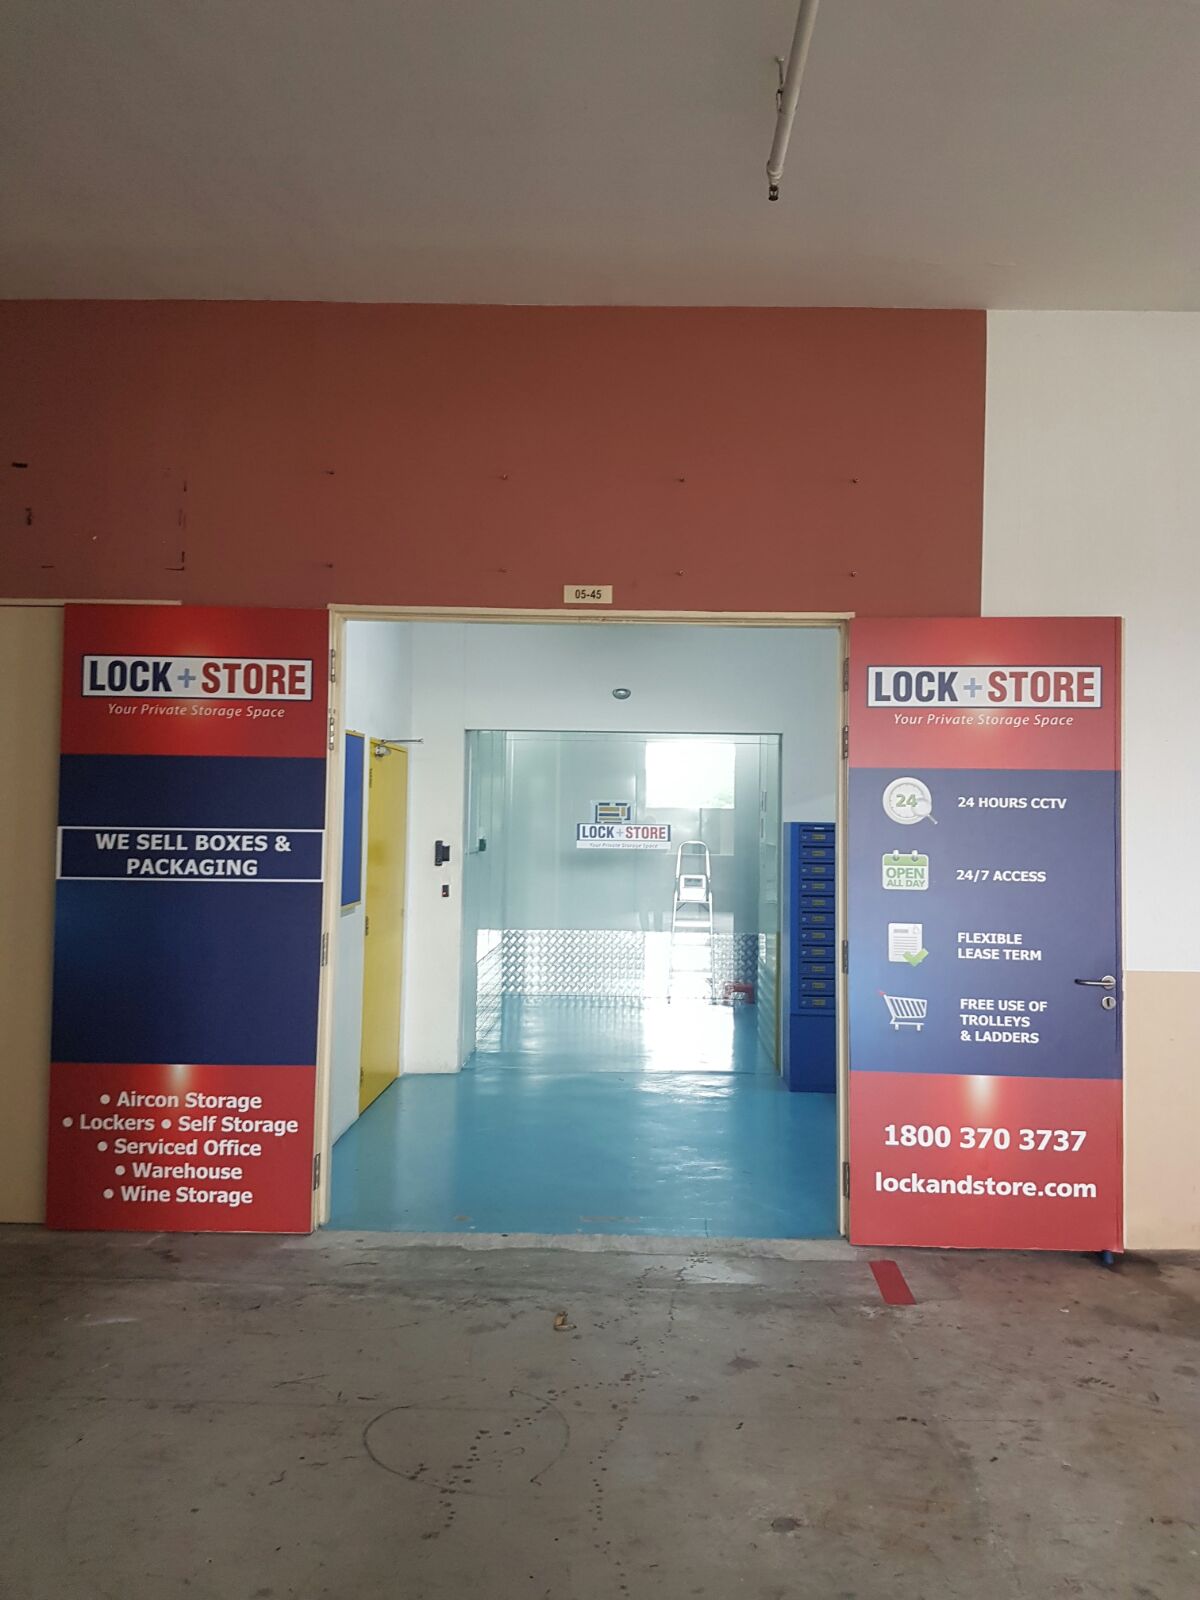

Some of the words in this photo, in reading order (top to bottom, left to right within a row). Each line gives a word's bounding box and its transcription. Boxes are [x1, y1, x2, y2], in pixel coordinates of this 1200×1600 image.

[575, 589, 602, 599] 05-45
[89, 660, 173, 693] LOCK
[202, 662, 306, 694] STORE
[874, 671, 959, 703] LOCK
[987, 671, 1095, 703] STORE
[107, 703, 137, 716] Your
[140, 703, 187, 716] Private
[190, 704, 242, 719] Storage
[246, 706, 286, 719] Space
[894, 713, 923, 726] Your
[927, 713, 974, 726] Private
[977, 714, 1030, 729] Storage
[1033, 715, 1074, 728] Space
[958, 796, 975, 809] 24
[978, 797, 1028, 809] HOURS
[1031, 798, 1067, 810] CCTV
[582, 826, 614, 838] LOCK
[625, 826, 667, 840] STORE
[95, 833, 130, 850] WE
[136, 834, 188, 851] SELL
[195, 835, 268, 852] BOXES
[274, 836, 292, 852] &
[126, 858, 259, 876] PACKAGING
[885, 867, 926, 880] OPEN
[886, 879, 904, 888] ALL
[905, 879, 926, 888] DAY
[956, 870, 989, 882] 24/7
[993, 870, 1047, 882] ACCESS
[957, 932, 1023, 945] FLEXIBLE
[957, 947, 1000, 960] LEASE
[1002, 948, 1042, 961] TERM
[960, 998, 995, 1011] FREE
[998, 1000, 1026, 1012] USE
[1028, 1000, 1048, 1012] OF
[960, 1014, 1031, 1028] TROLLEYS
[960, 1030, 972, 1042] &
[975, 1031, 1039, 1044] LADDERS
[117, 1091, 179, 1108] Aircon
[184, 1091, 263, 1112] Storage
[80, 1113, 155, 1131] Lockers
[178, 1115, 217, 1132] Self
[221, 1117, 299, 1137] Storage
[884, 1124, 951, 1148] 1800
[959, 1128, 1010, 1150] 370
[1018, 1129, 1087, 1152] 3737
[114, 1138, 198, 1155] Serviced
[203, 1139, 262, 1157] Office
[132, 1162, 243, 1180] Warehouse
[875, 1171, 1097, 1199] lockandstore.com
[120, 1186, 170, 1203] Wine
[175, 1186, 254, 1207] Storage
